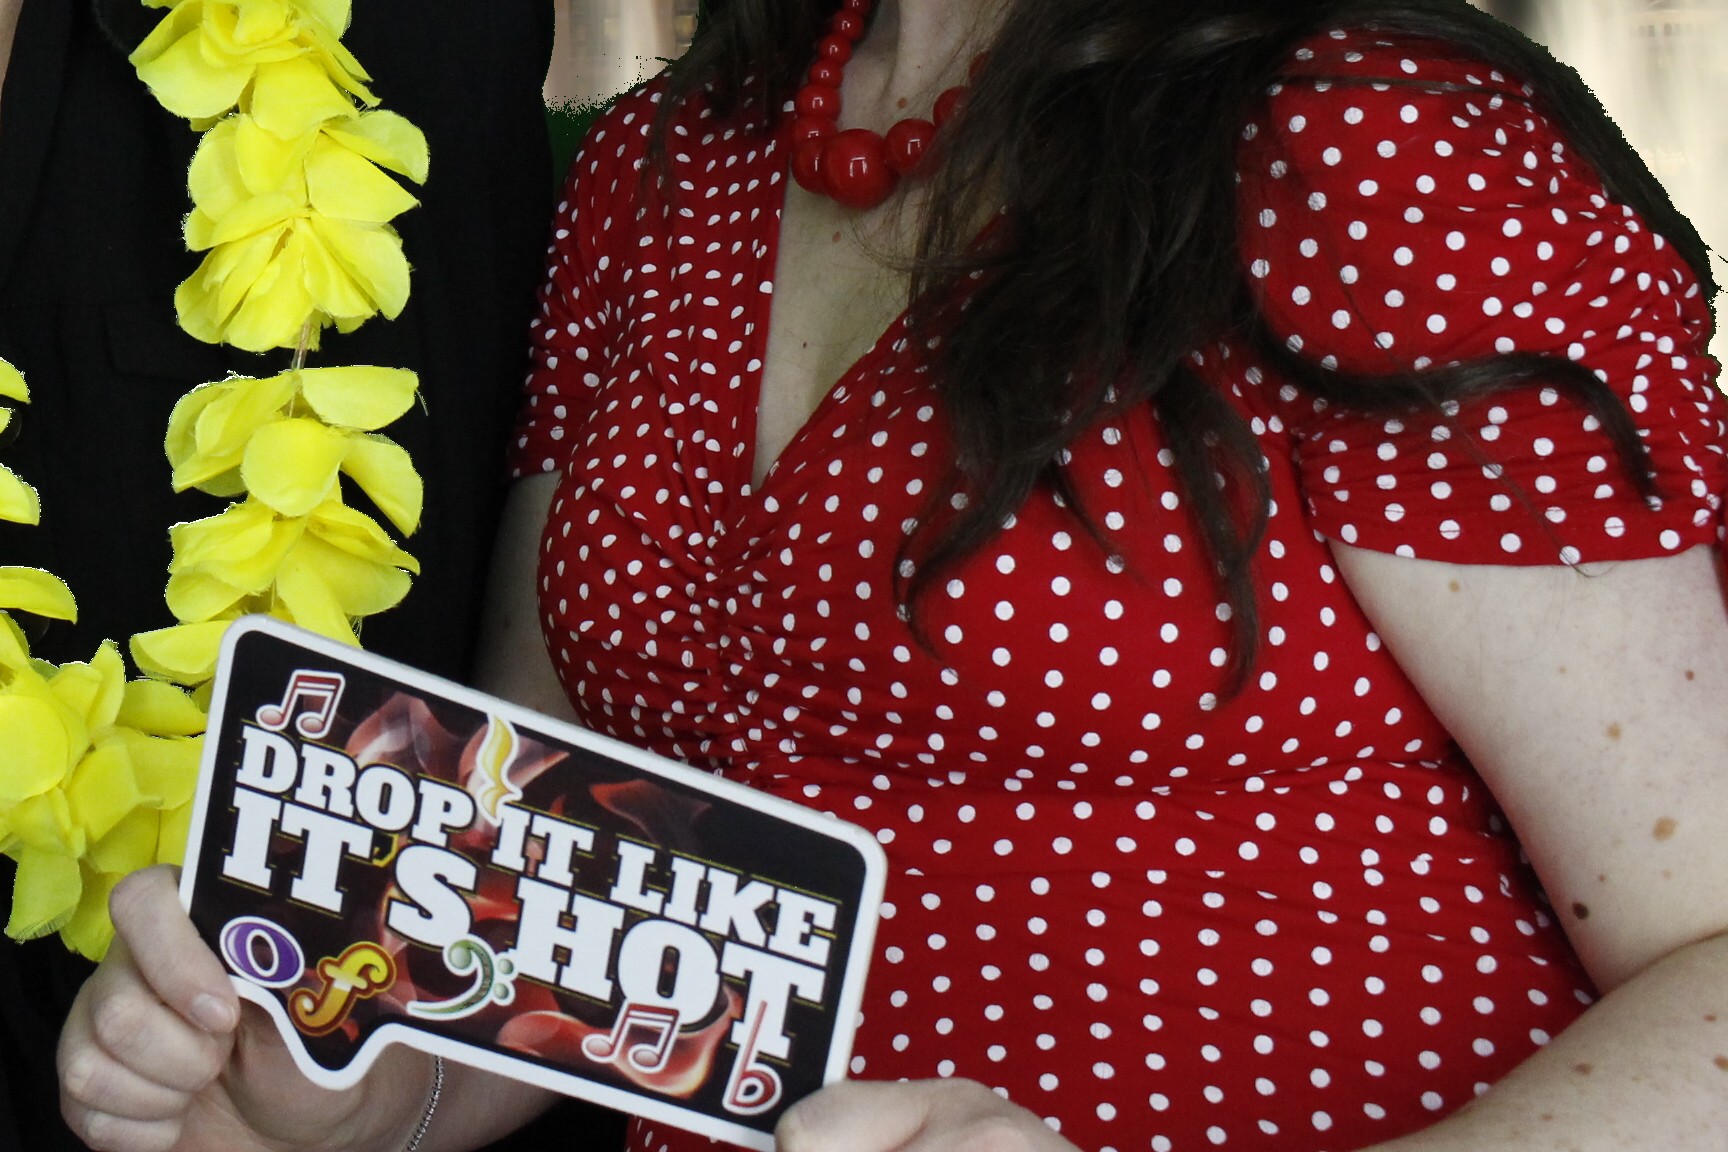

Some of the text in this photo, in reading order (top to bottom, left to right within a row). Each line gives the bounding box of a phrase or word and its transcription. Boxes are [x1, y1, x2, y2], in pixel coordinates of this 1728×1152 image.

[235, 725, 840, 967] DROP IT LIKE
[511, 876, 827, 1058] HOT
